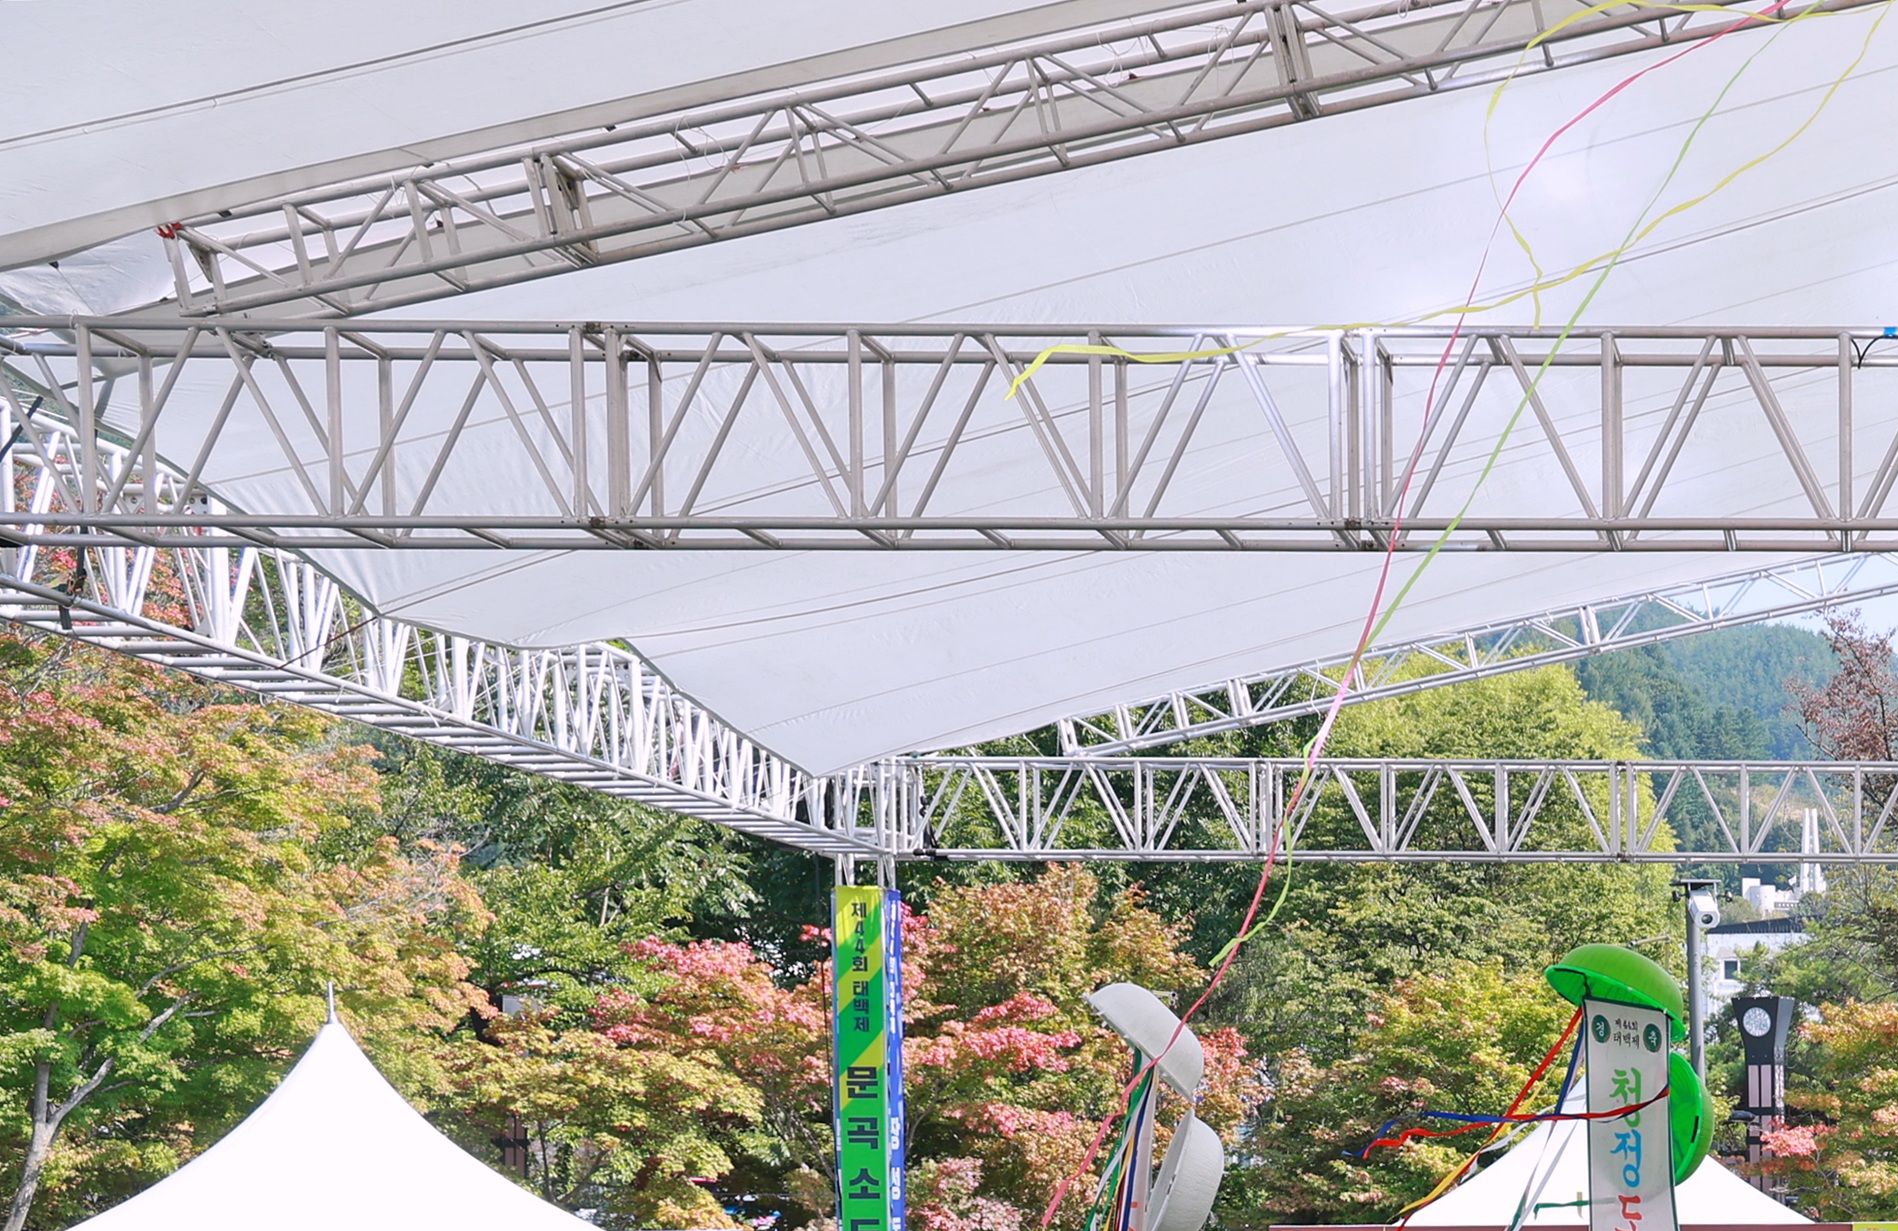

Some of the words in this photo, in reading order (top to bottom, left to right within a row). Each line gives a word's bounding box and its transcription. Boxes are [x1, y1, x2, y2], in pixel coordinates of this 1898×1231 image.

[851, 902, 868, 972] 제44회
[853, 981, 870, 1033] 태백제
[1613, 1032, 1640, 1049] 태백제
[1614, 1018, 1638, 1032] 제44회
